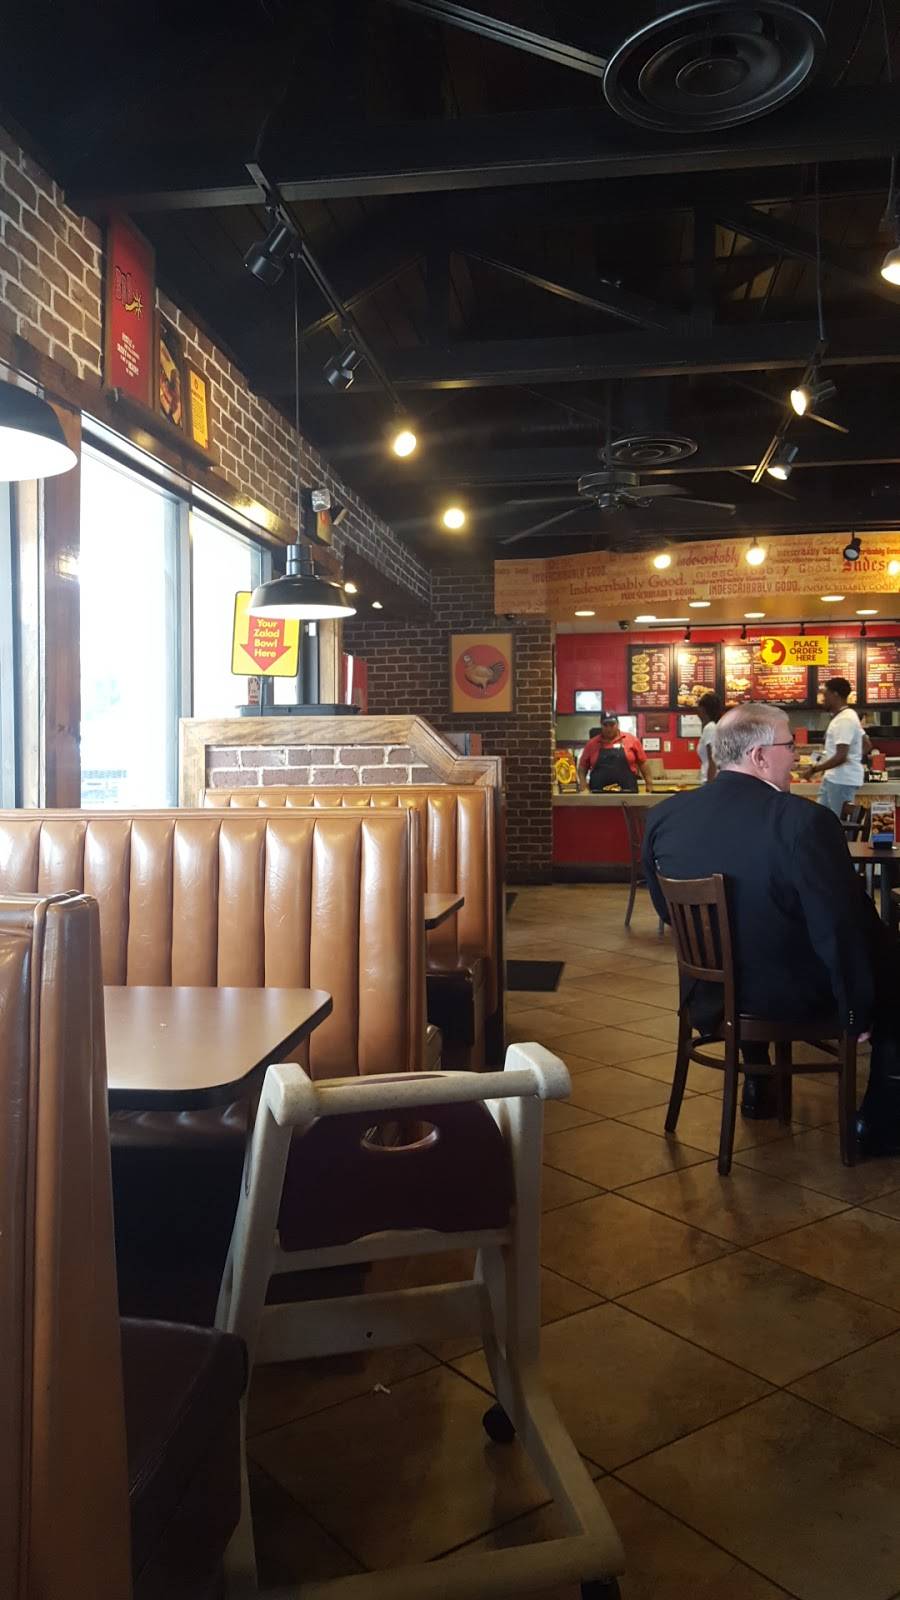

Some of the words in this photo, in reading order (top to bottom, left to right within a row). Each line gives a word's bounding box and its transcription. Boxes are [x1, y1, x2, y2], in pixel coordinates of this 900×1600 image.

[648, 572, 688, 588] Good.
[257, 618, 278, 628] Your
[254, 629, 280, 638] Zalad
[254, 638, 278, 648] Bowl
[254, 649, 277, 658] Here
[789, 647, 823, 655] ORDERS
[796, 654, 816, 662] HERE
